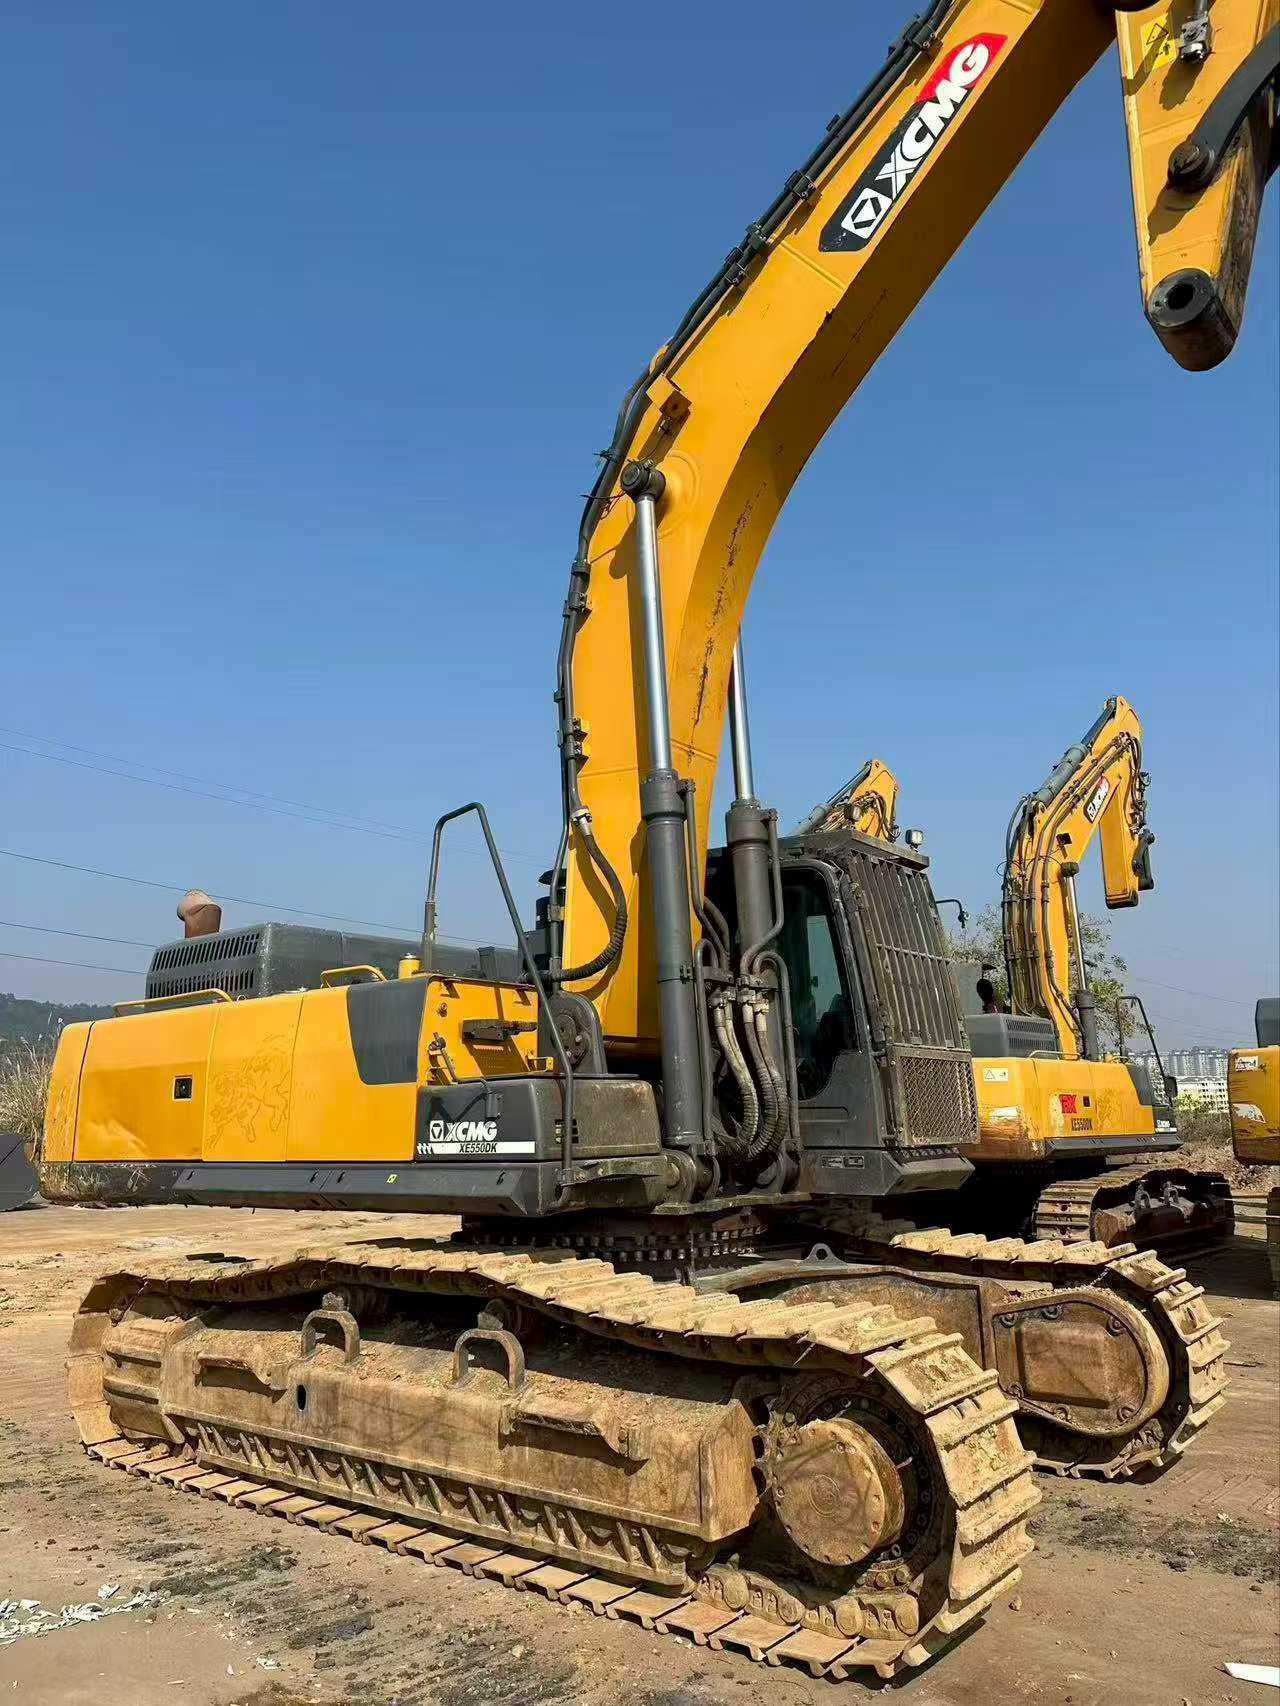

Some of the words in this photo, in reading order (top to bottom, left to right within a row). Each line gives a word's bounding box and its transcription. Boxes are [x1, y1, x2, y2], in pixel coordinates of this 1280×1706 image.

[875, 42, 990, 200] XCMG
[445, 1121, 498, 1142] XCMG
[459, 1143, 498, 1154] XE550DK
